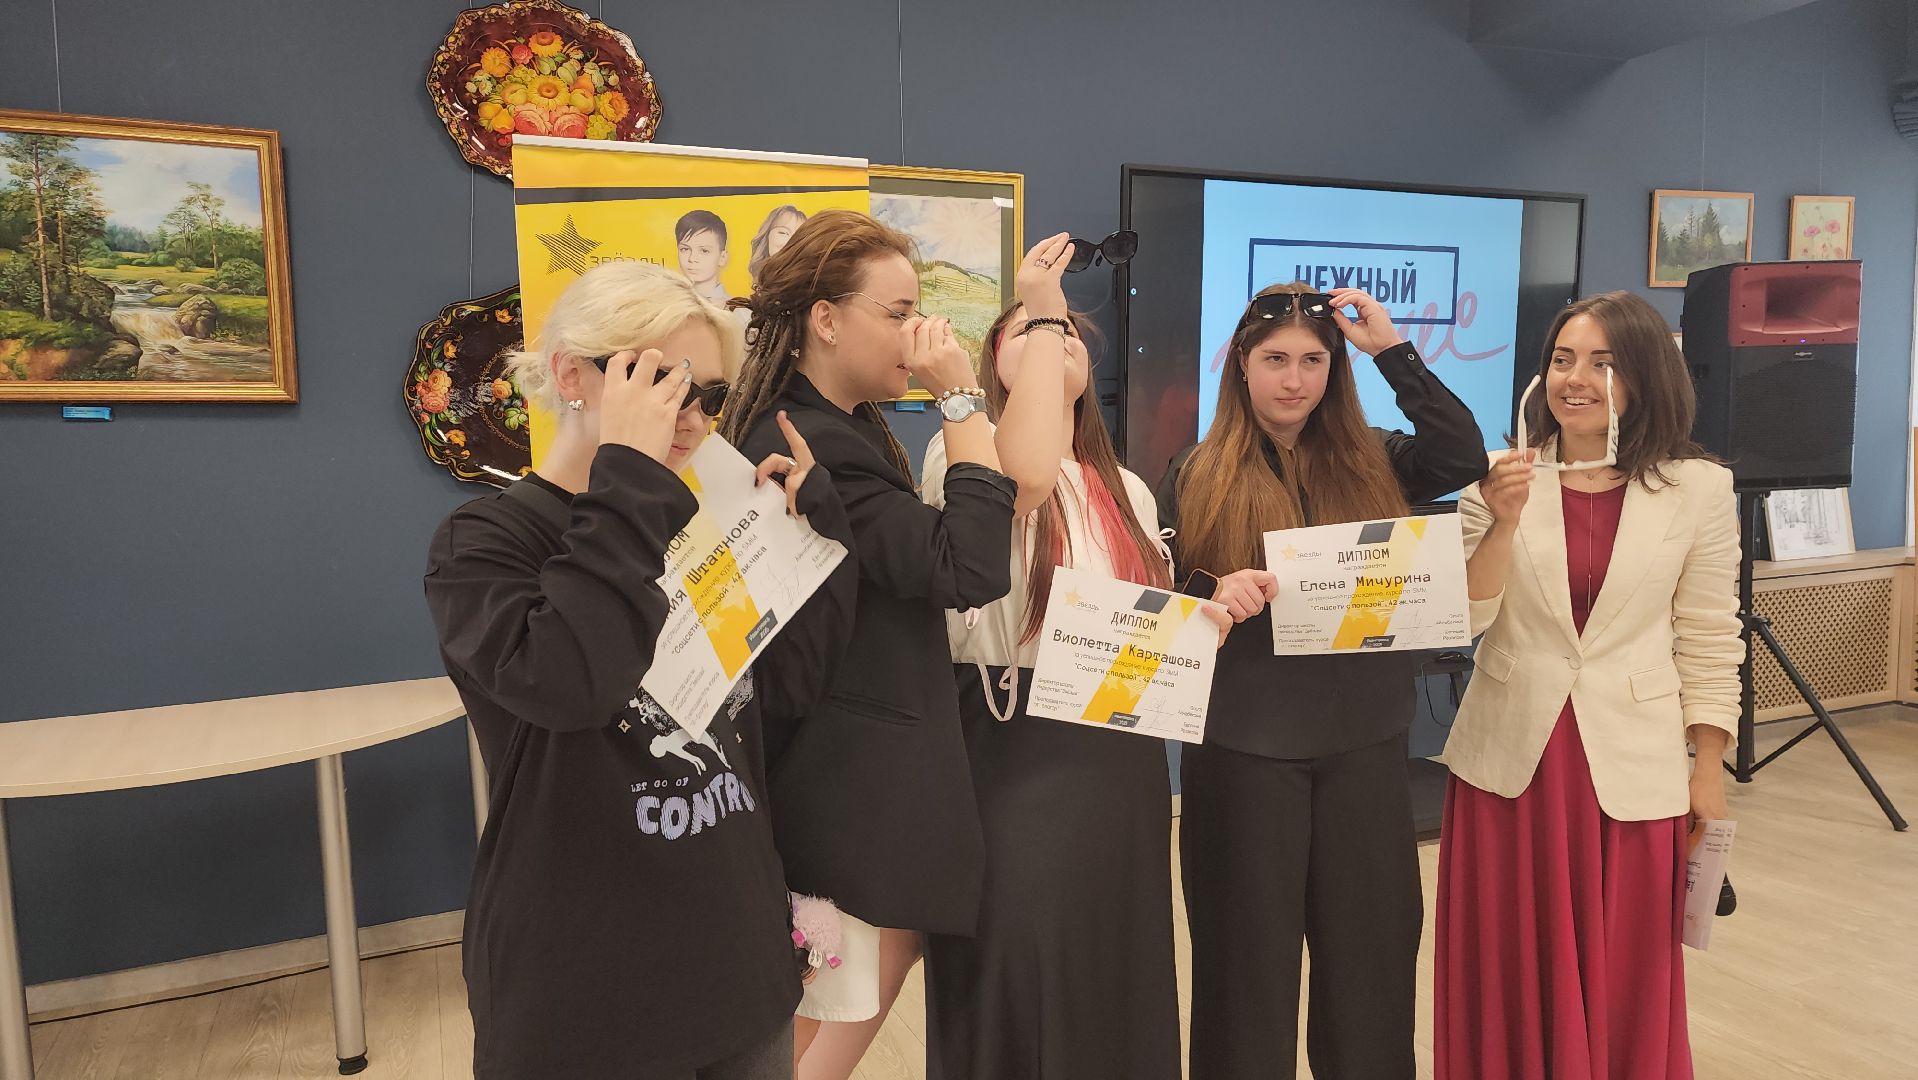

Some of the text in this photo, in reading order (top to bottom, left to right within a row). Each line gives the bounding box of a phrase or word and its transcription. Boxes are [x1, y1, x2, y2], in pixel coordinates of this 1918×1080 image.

[685, 507, 759, 585] Штатнова
[1337, 547, 1389, 564] ДИПЛОМ
[731, 572, 743, 584] 42
[1300, 573, 1431, 591] Елена Мичурина
[1110, 611, 1158, 631] ДИПЛОМ
[1052, 628, 1201, 669] Виолетта Карташова
[653, 779, 668, 788] GO
[675, 776, 689, 788] OF
